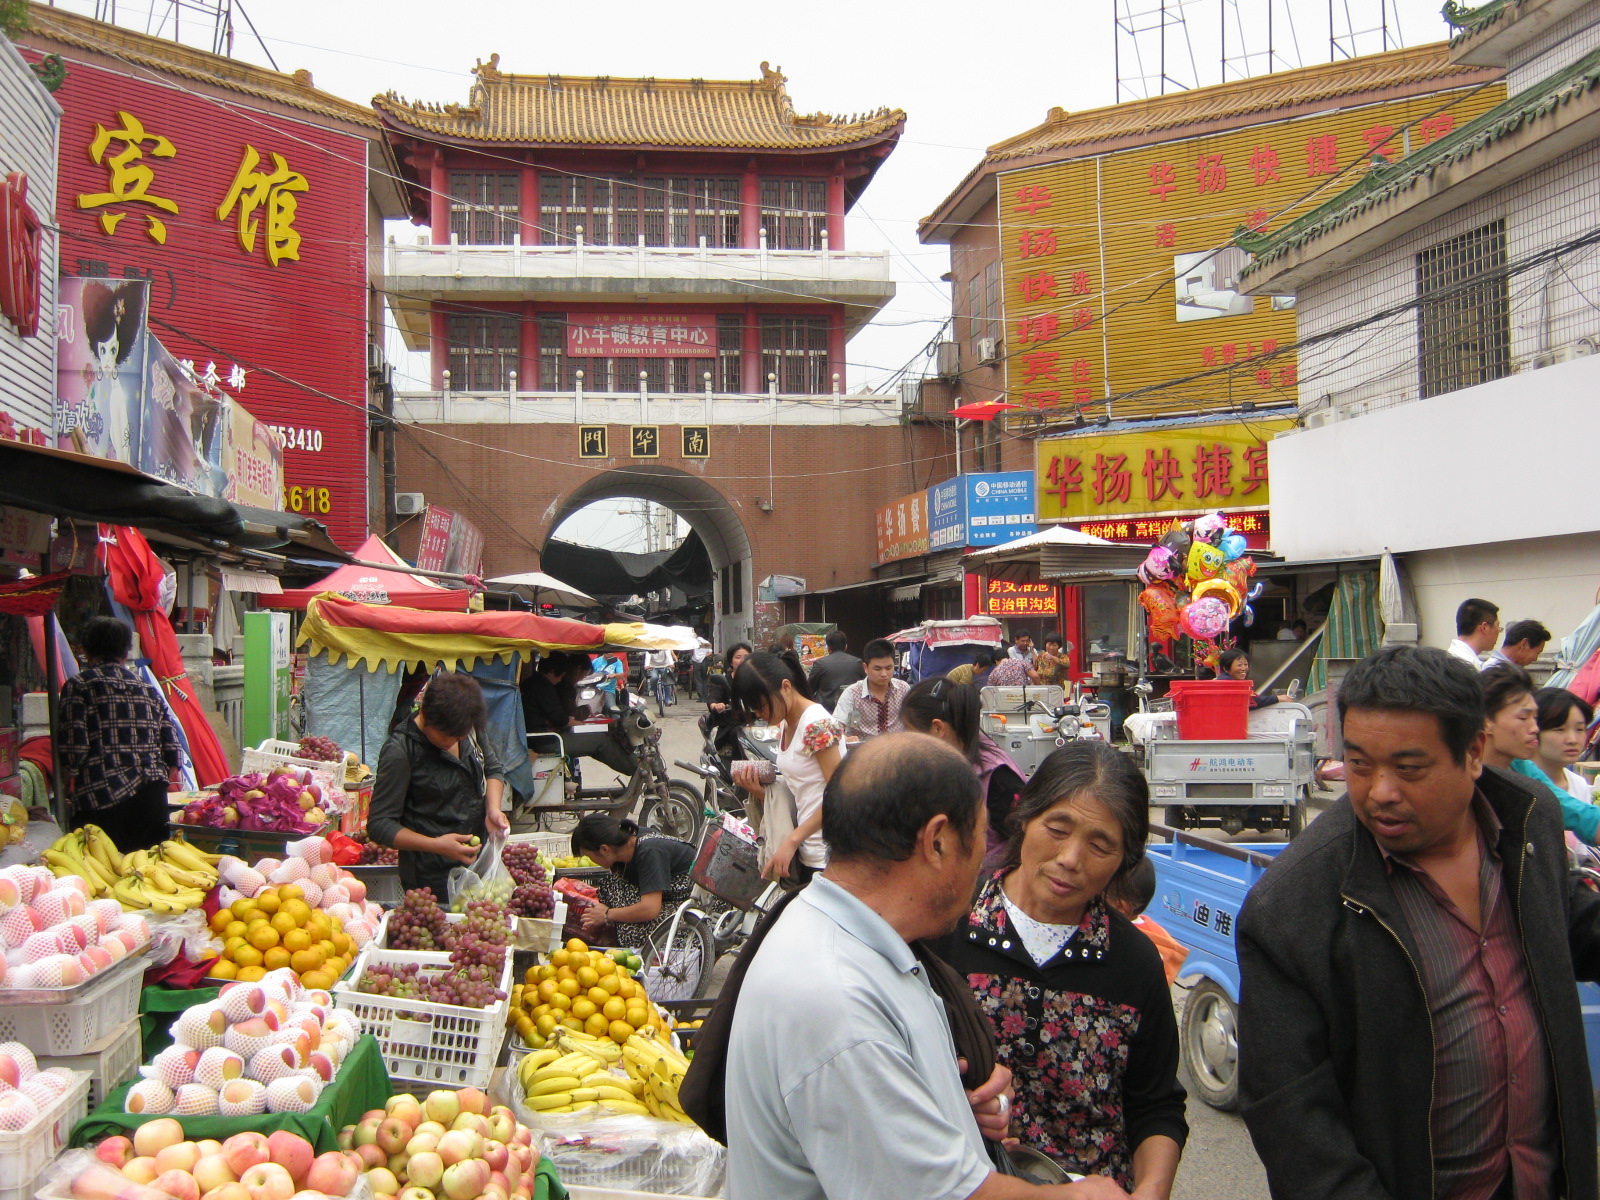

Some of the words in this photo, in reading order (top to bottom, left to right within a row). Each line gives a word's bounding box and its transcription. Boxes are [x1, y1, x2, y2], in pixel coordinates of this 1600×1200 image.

[76, 111, 310, 267] 宾馆
[571, 324, 709, 346] 小牛顿教育中心
[991, 480, 1028, 490] 中国移动通信
[991, 488, 1009, 496] CHINA
[1009, 487, 1028, 495] MOBILE
[988, 597, 1055, 612] 包治甲沟炎
